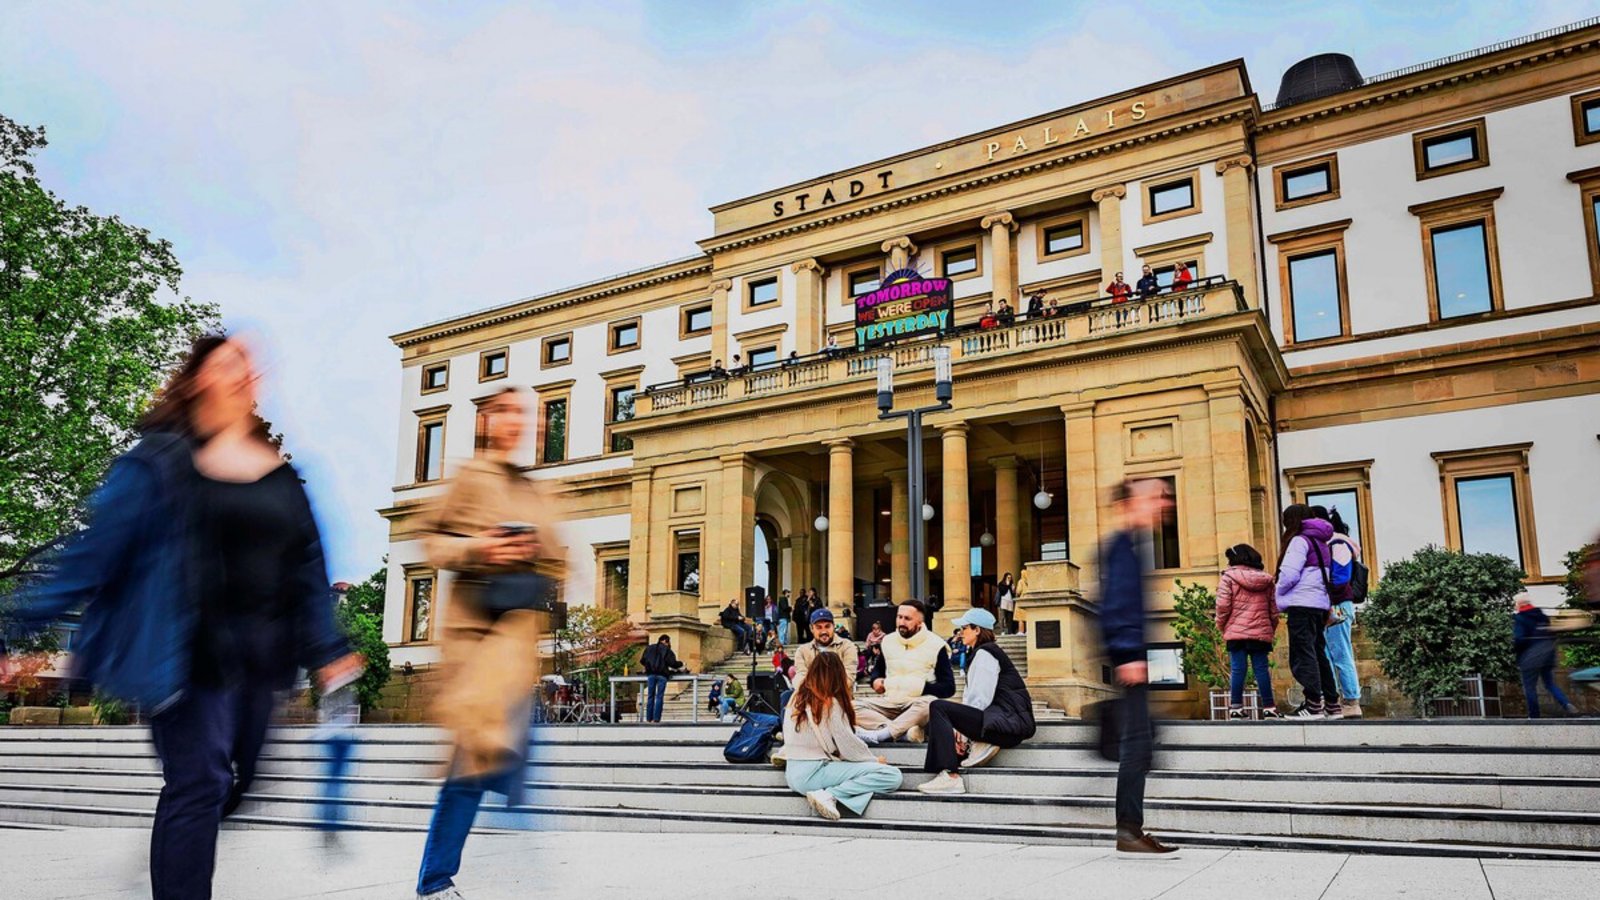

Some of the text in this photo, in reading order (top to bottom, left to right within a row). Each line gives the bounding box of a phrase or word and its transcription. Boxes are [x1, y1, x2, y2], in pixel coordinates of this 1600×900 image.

[773, 101, 1146, 217] STADT PALAIS
[856, 279, 948, 308] TOMORROW
[858, 295, 947, 322] WE WERE OPEN
[856, 309, 949, 351] YESTERDAY
